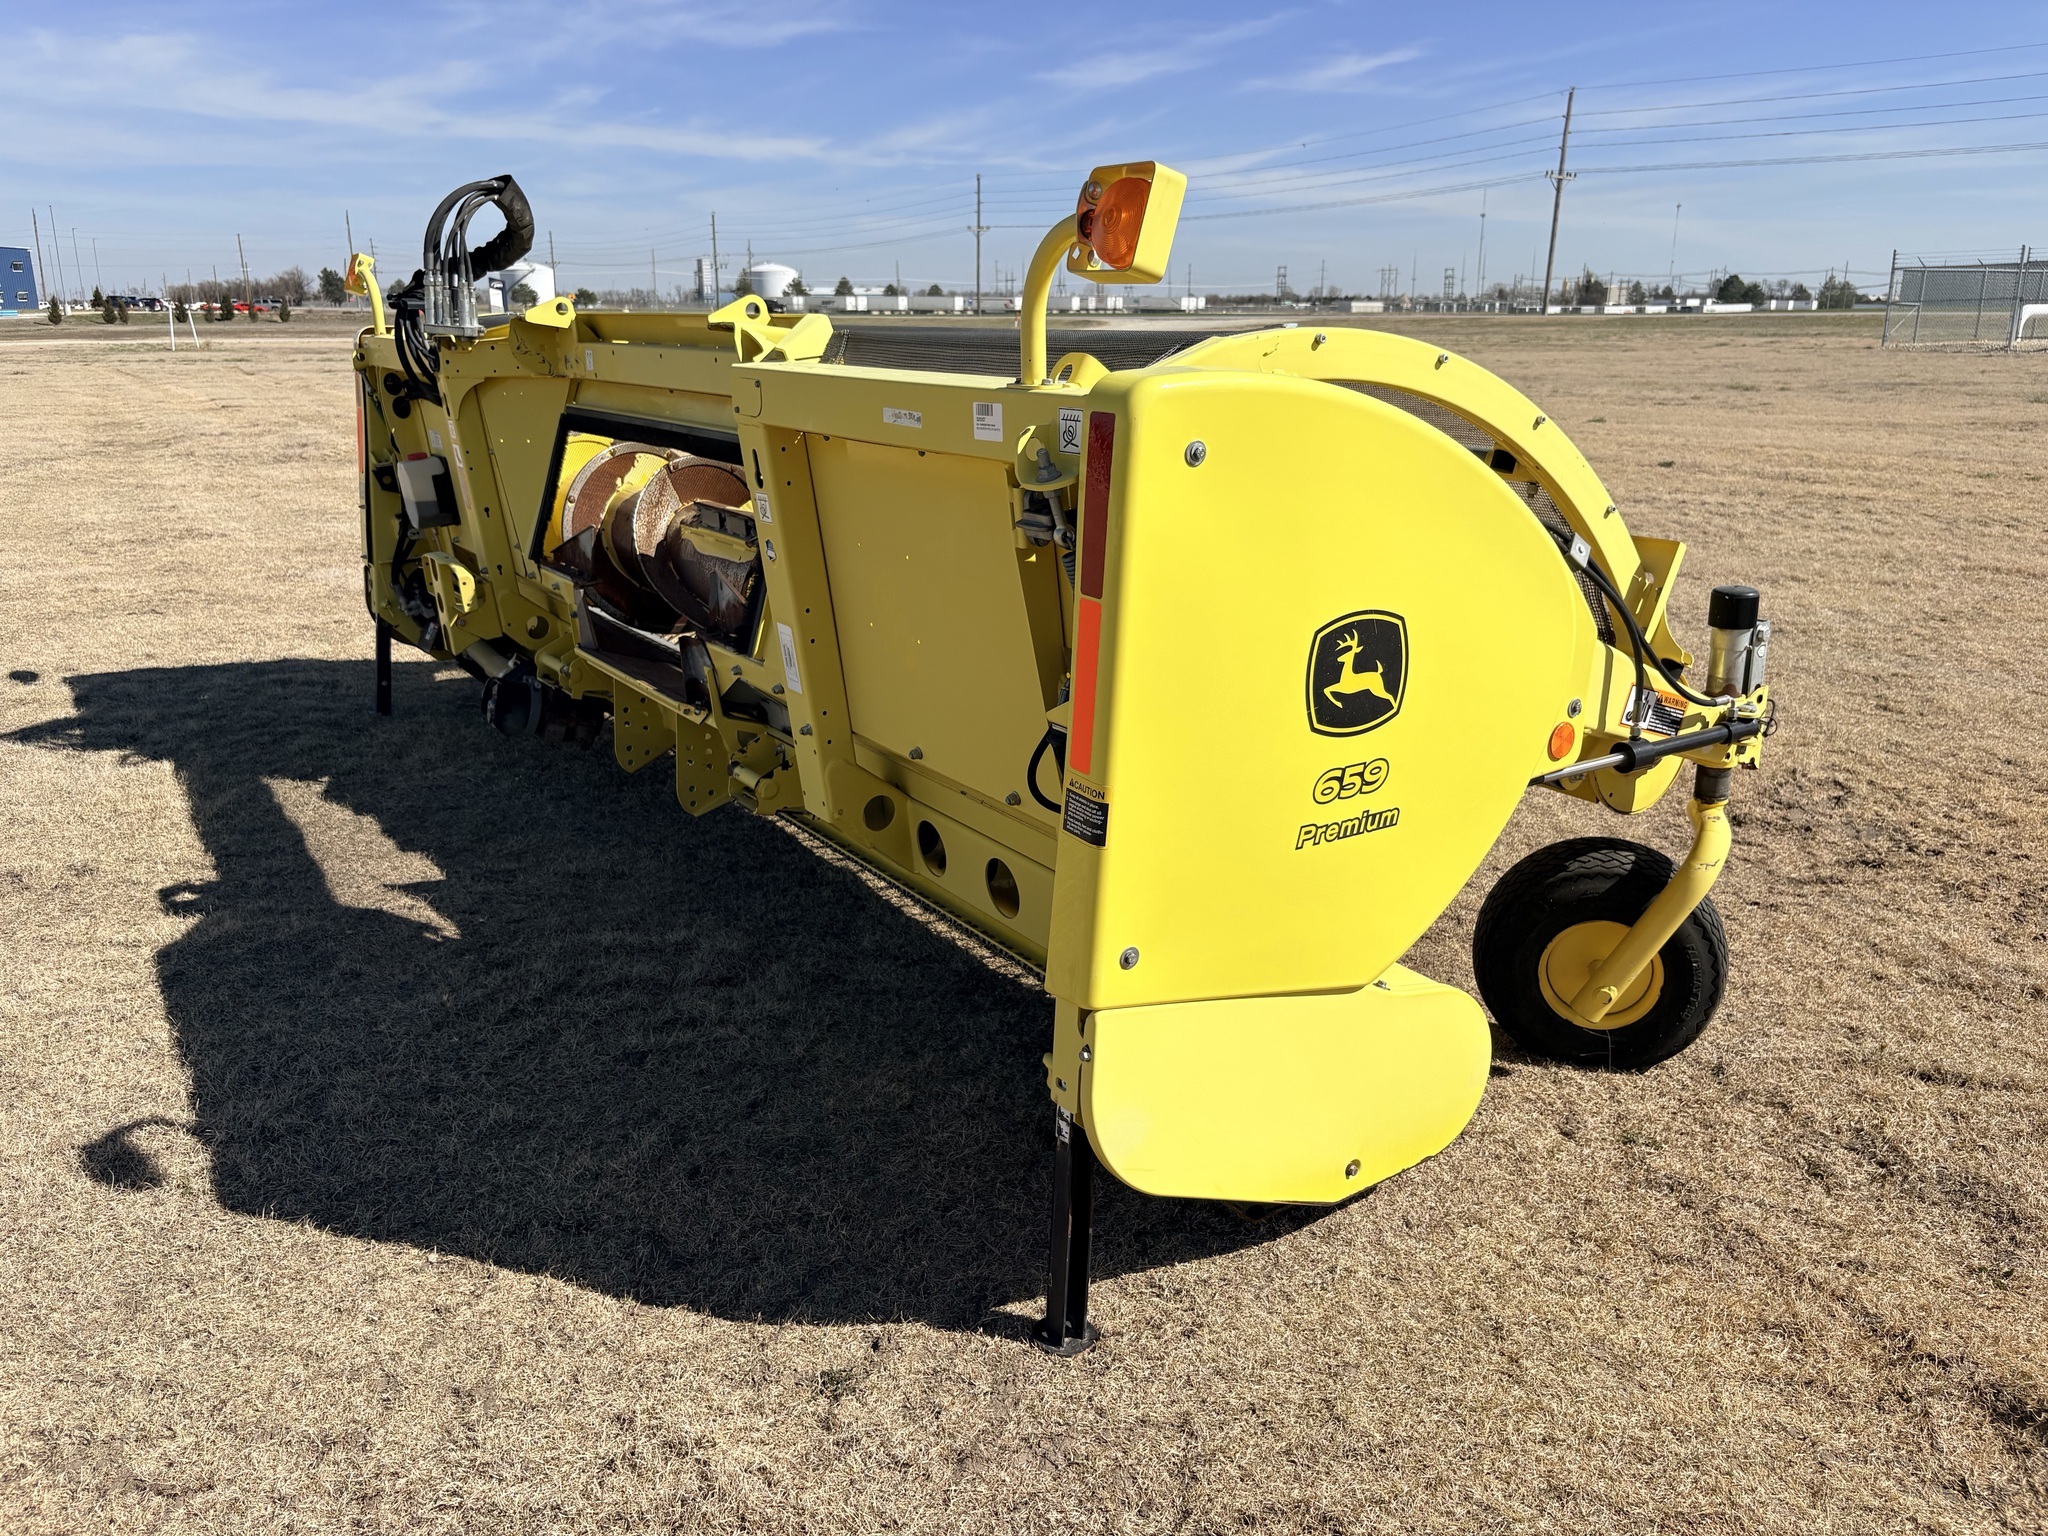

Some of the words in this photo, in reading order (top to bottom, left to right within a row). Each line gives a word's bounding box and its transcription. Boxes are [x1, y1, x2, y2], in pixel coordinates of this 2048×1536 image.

[1664, 696, 1687, 709] WARNING
[1074, 781, 1105, 800] CAUTION
[1312, 757, 1390, 805] 659
[1295, 807, 1401, 850] Premium
